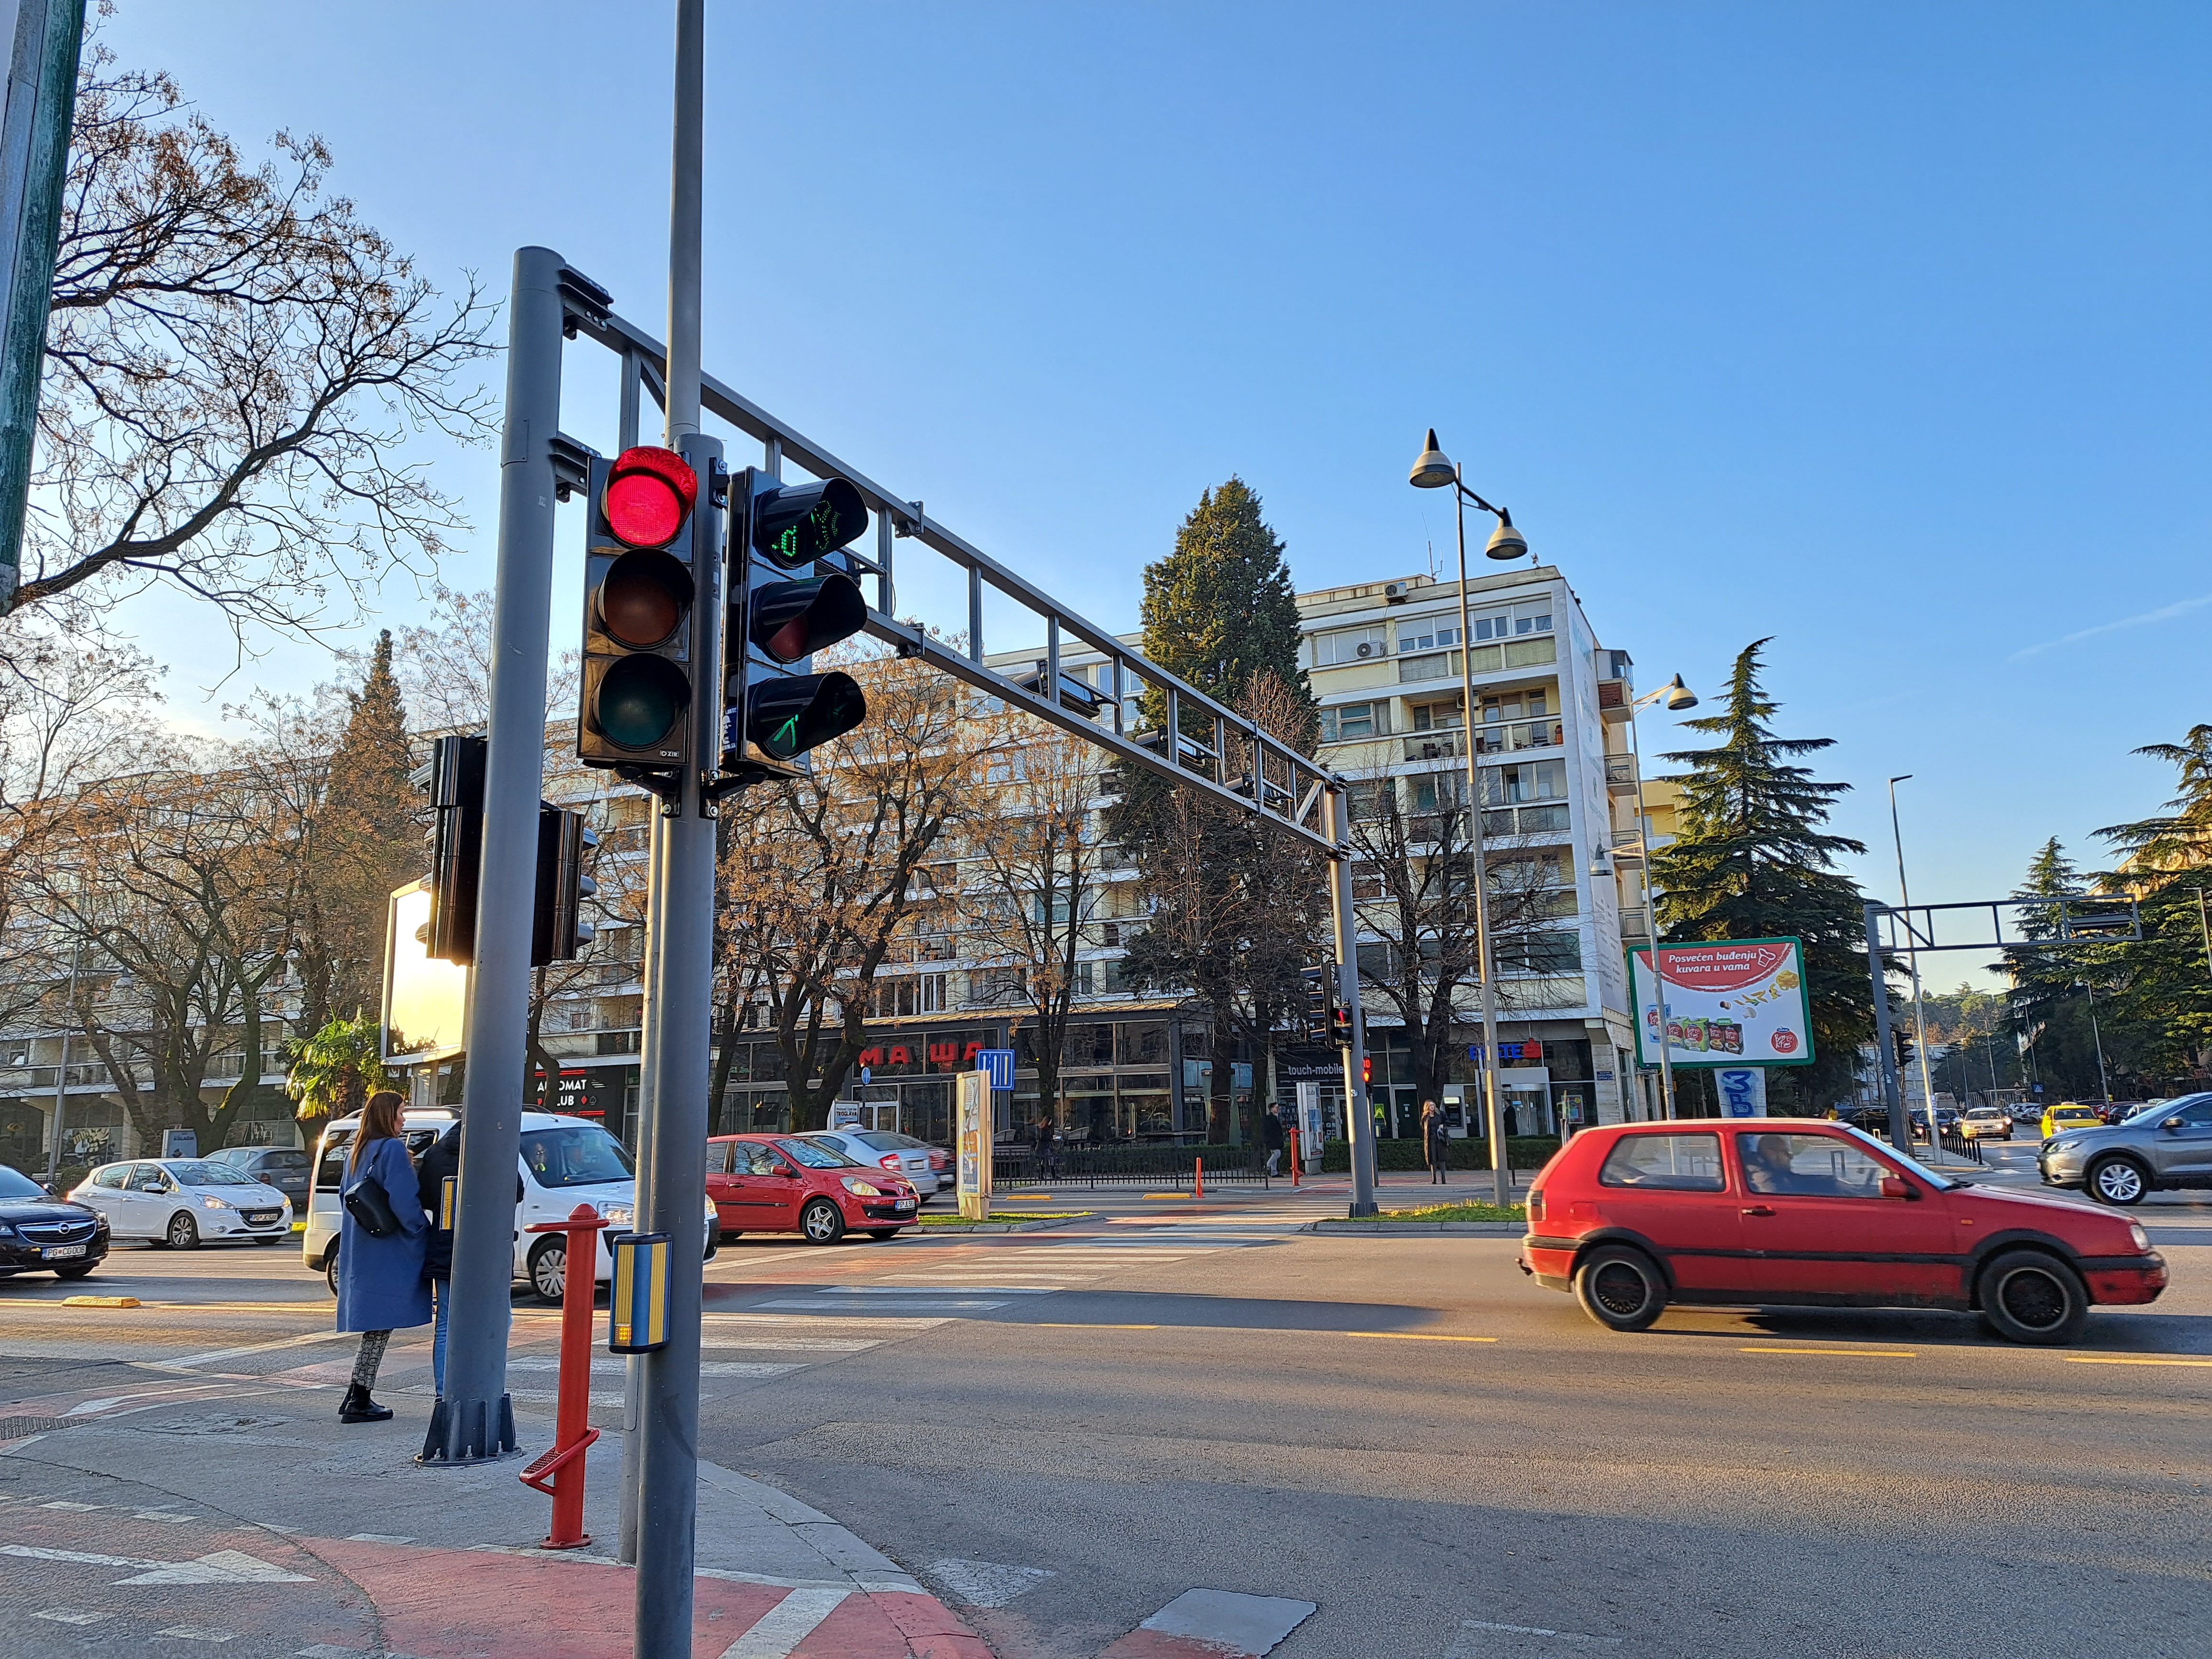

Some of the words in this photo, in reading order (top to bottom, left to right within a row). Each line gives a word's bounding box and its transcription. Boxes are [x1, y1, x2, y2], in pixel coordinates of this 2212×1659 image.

[1669, 952, 1714, 963] Posvećen
[1716, 951, 1757, 961] buđenju
[1676, 965, 1711, 973] kuvara
[1288, 1063, 1343, 1075] touch-mobile
[48, 1249, 57, 1257] PG
